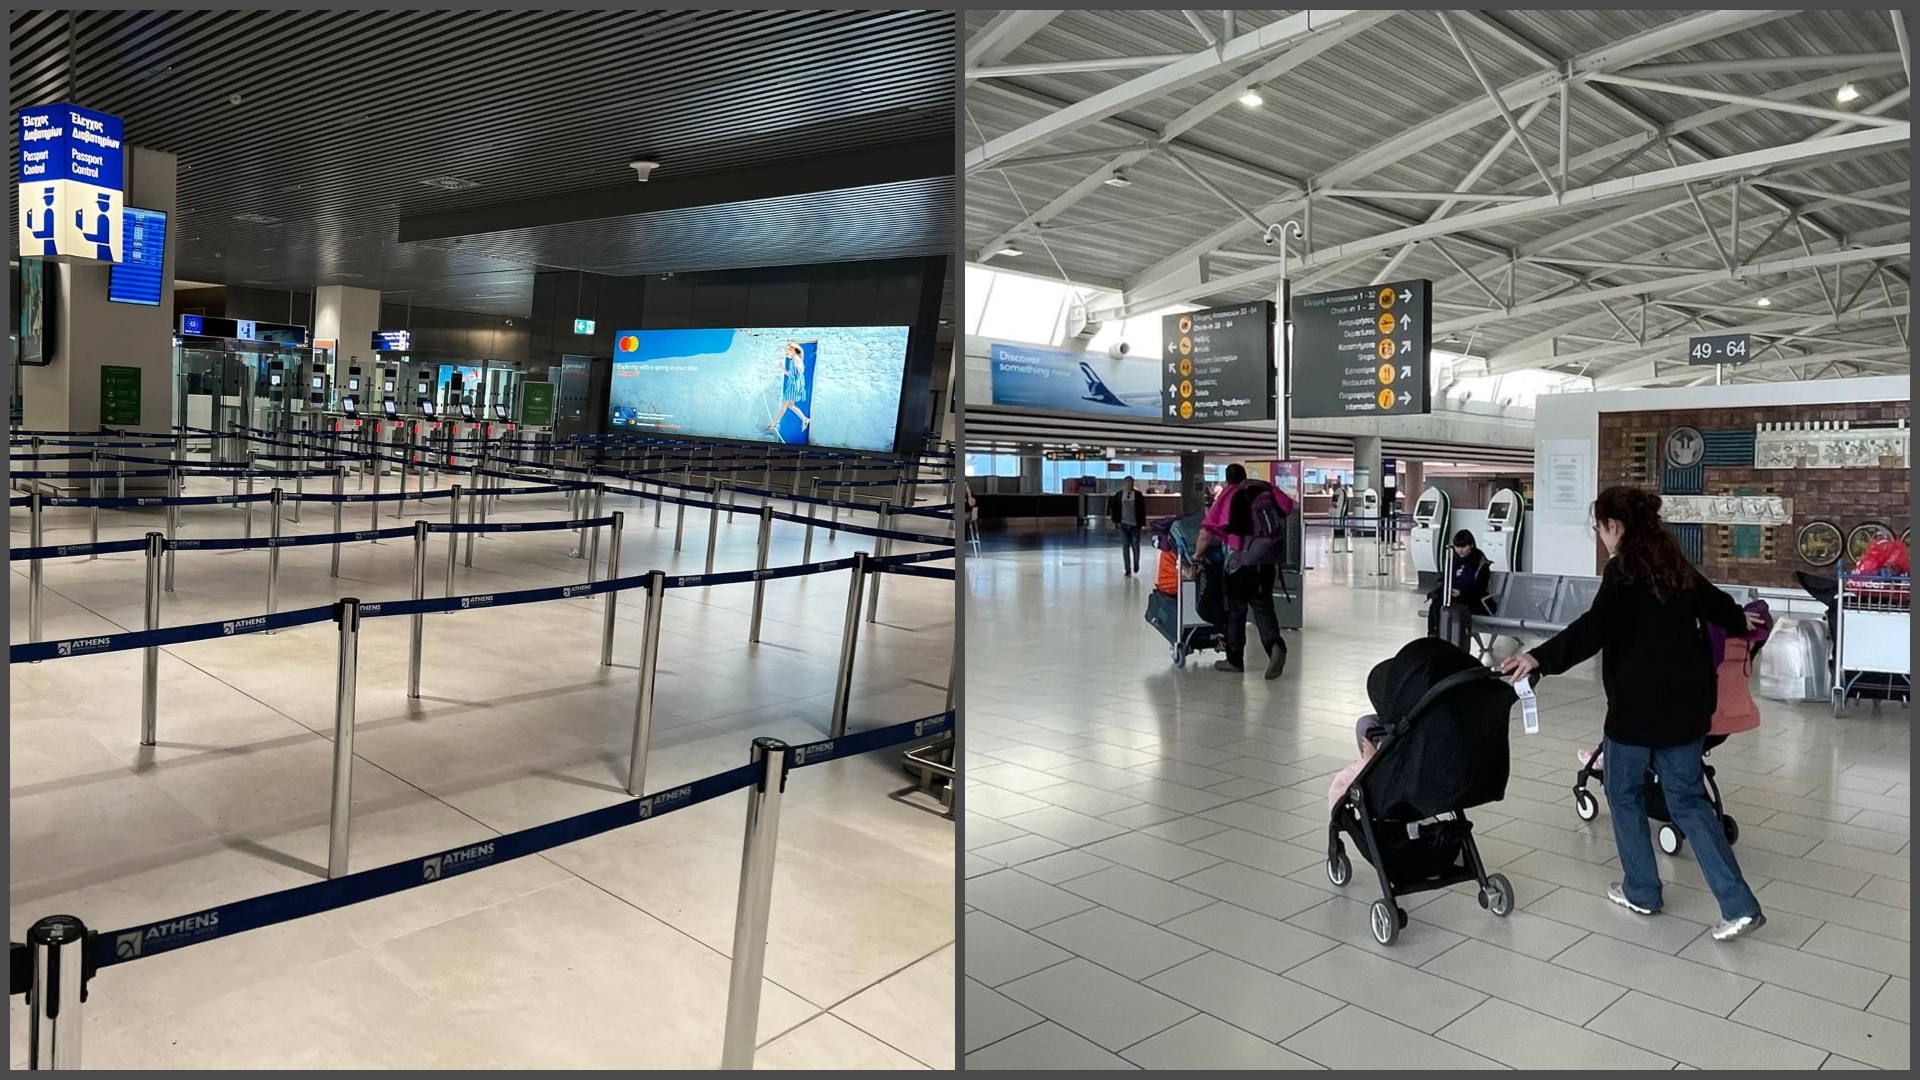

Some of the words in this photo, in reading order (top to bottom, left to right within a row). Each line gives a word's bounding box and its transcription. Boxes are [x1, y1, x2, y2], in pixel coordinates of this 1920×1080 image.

[72, 127, 120, 149] Διαβατηρίων
[23, 150, 49, 162] Passport
[71, 148, 104, 166] Passport
[23, 163, 46, 175] Control
[71, 162, 99, 178] Control
[1344, 329, 1376, 338] Departures
[1692, 343, 1712, 359] 49
[1726, 340, 1746, 356] 64
[1000, 351, 1040, 364] Discover
[1357, 353, 1376, 361] Shops
[999, 363, 1050, 378] something
[1344, 403, 1376, 411] Information
[571, 583, 592, 591] ATHENS
[470, 595, 494, 603] ATHENS
[235, 616, 267, 629] ATHENS
[72, 637, 111, 650] ATHENS
[923, 715, 946, 726] ATHENS
[806, 740, 835, 755] ATHENS
[652, 785, 692, 806] ATHENS
[443, 842, 495, 866] ATHENS
[145, 911, 219, 941] ATHENS
